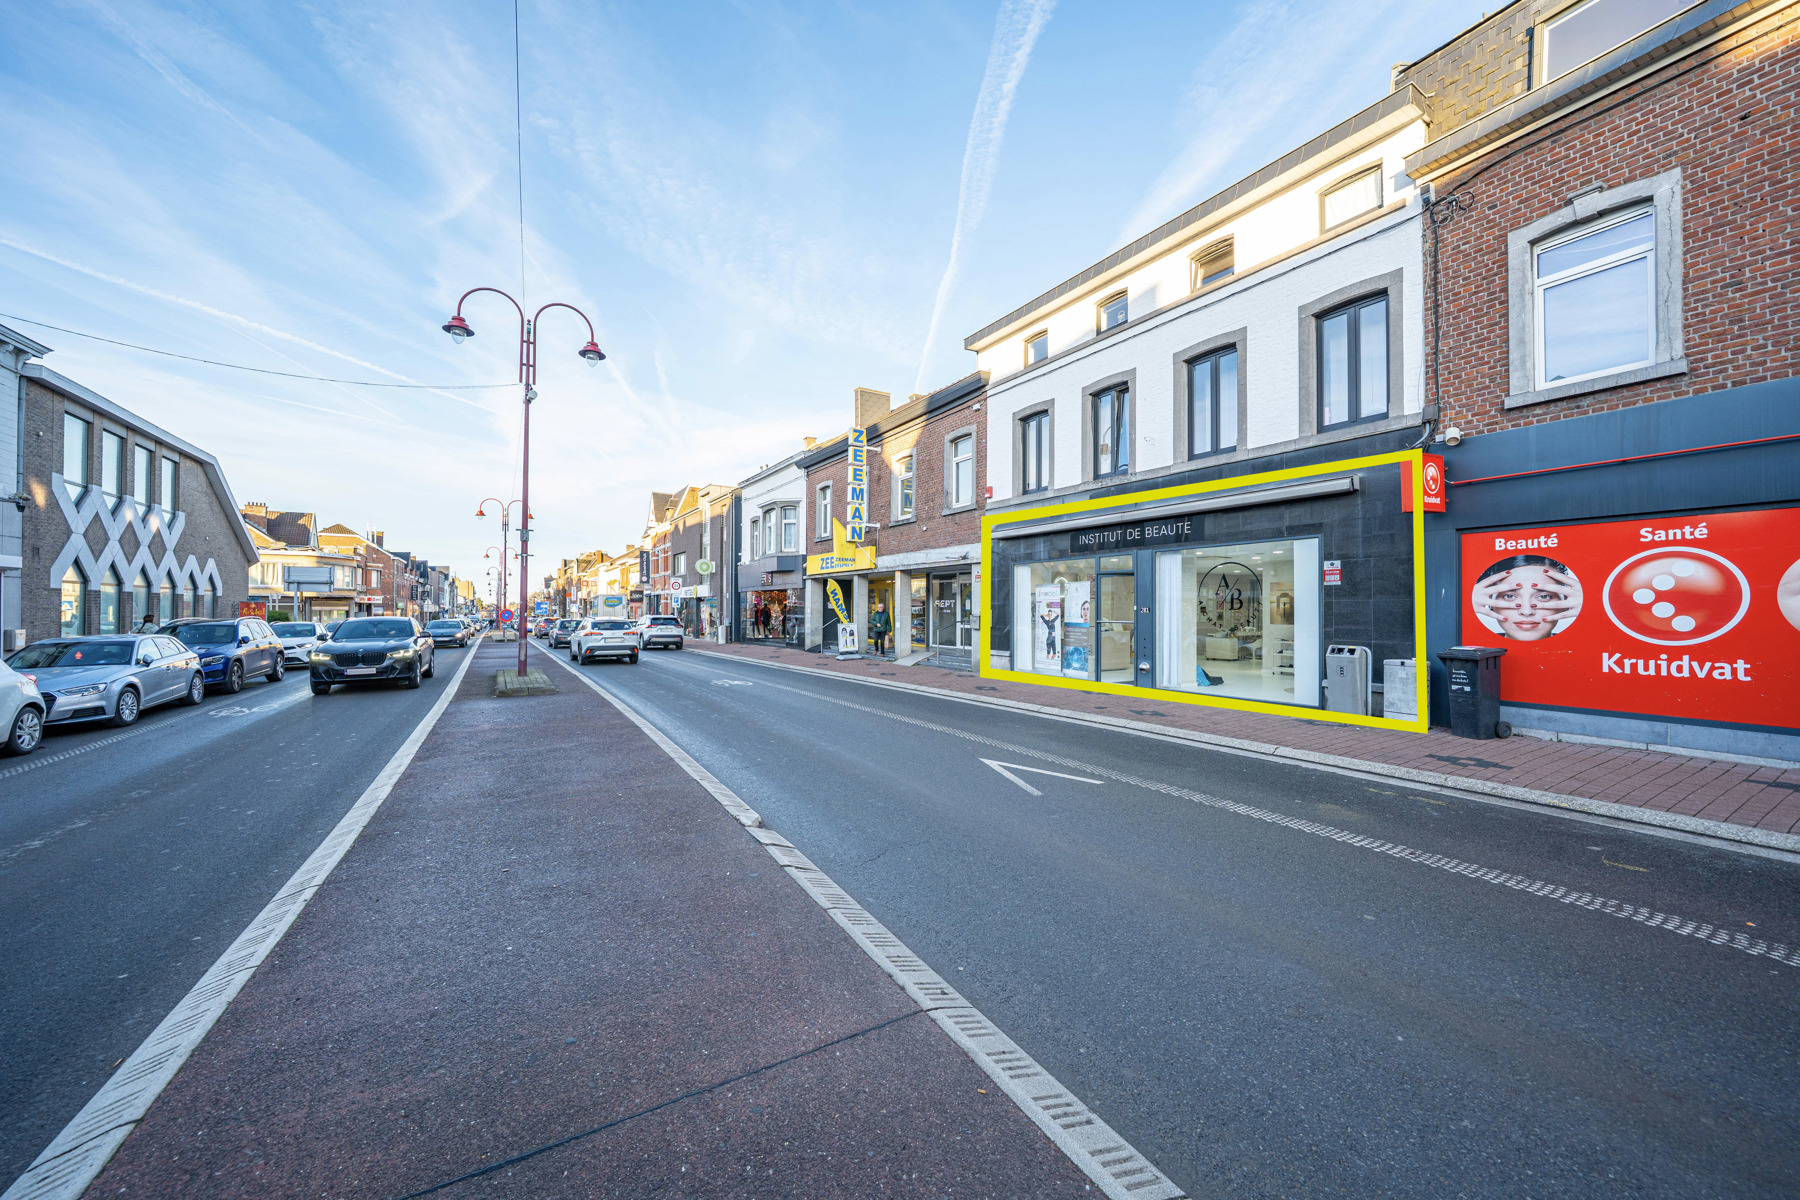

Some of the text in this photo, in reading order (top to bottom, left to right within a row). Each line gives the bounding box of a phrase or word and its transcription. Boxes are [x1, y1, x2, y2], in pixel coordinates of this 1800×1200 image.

[851, 428, 864, 541] ZEEMAN
[1424, 495, 1441, 504] Kruidvat
[1079, 530, 1122, 545] INSTITUT
[1126, 528, 1141, 540] DE
[1495, 533, 1558, 551] Beauté
[1640, 522, 1708, 542] Santé
[1234, 600, 1263, 631] BEAUTY
[1602, 652, 1752, 681] Kruidvat
